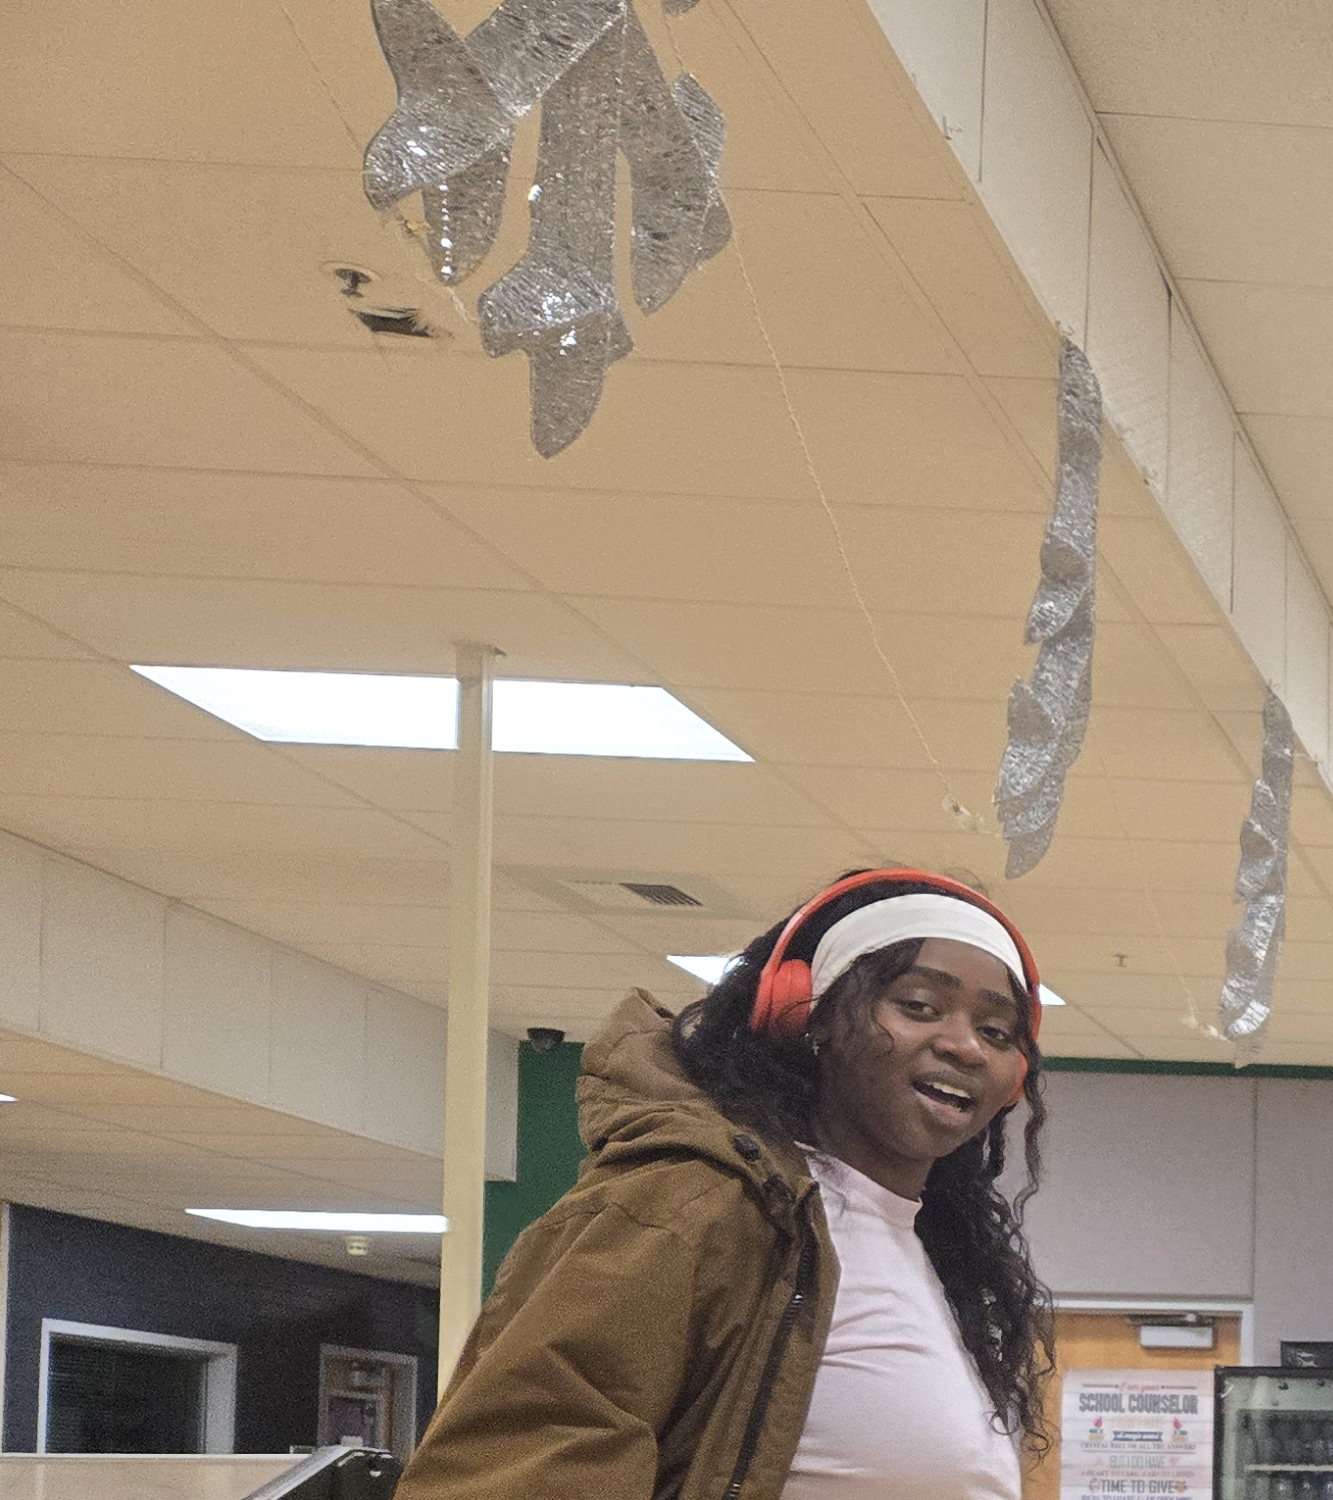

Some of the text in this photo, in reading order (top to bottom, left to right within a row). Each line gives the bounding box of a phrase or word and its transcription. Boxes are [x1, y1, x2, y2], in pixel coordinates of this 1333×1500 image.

[1079, 1392, 1199, 1414] SCHOOL COUNSELOR
[1100, 1479, 1176, 1494] TIME TO GIVE
